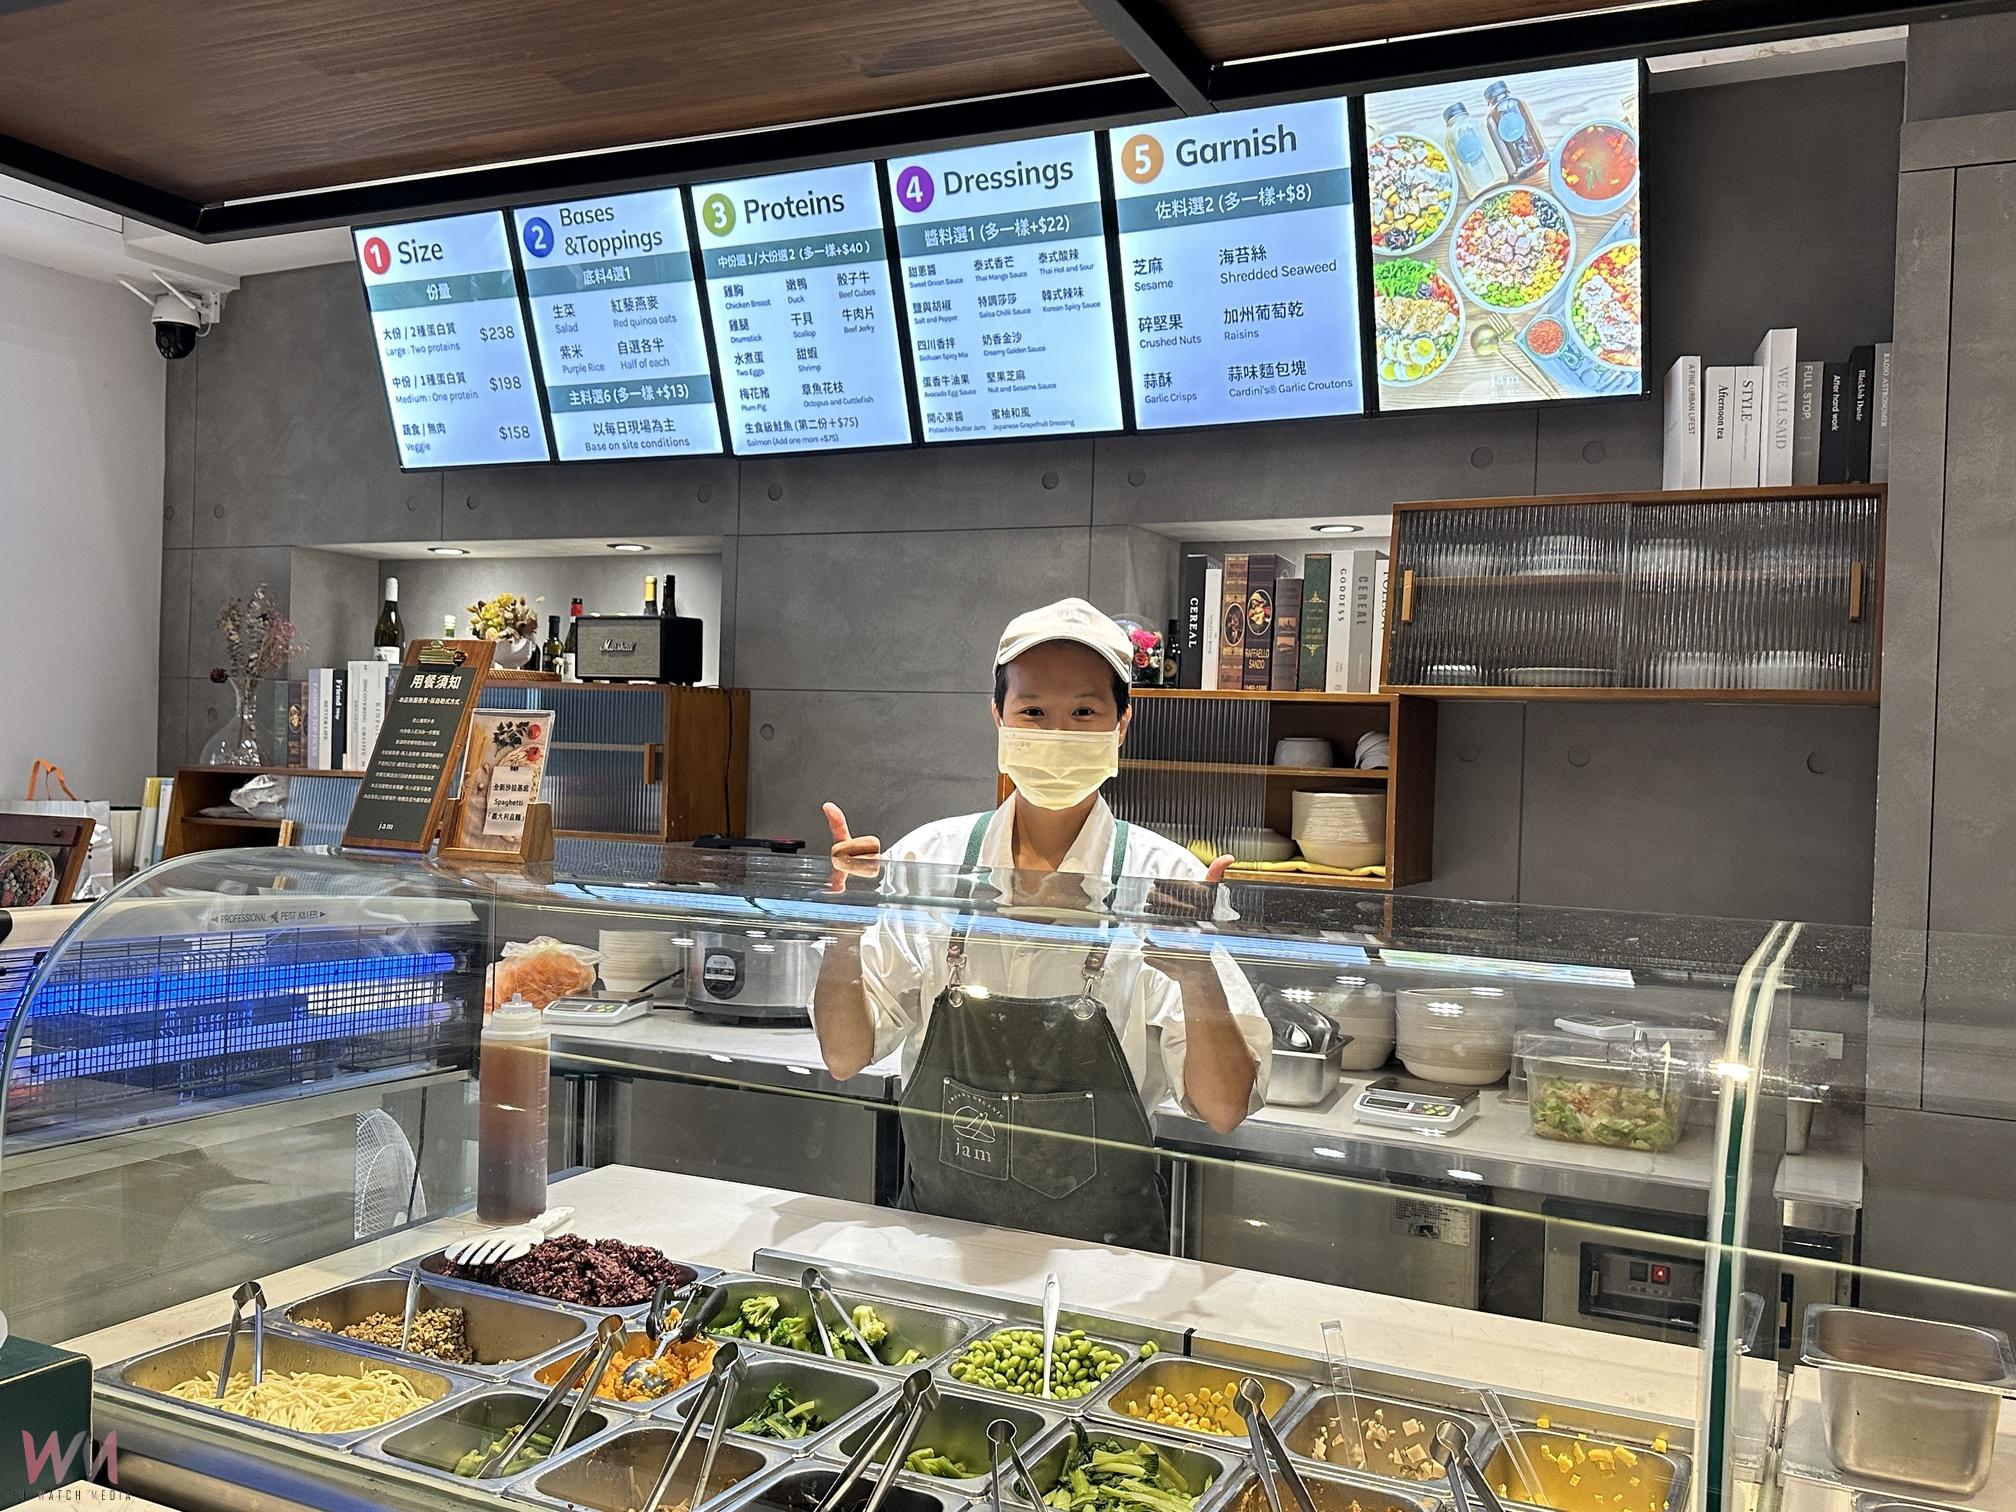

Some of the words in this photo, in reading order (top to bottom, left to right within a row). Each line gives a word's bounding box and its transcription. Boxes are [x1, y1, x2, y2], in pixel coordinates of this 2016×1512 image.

[1176, 124, 1296, 167] Garnish
[1135, 144, 1151, 175] 5
[944, 160, 1074, 196] Dressings
[906, 175, 923, 203] 4
[711, 201, 727, 229] 3
[744, 190, 844, 224] Proteins
[1155, 197, 1214, 220] 佐料選2
[560, 206, 614, 227] Bases
[531, 225, 546, 250] 2
[565, 230, 663, 258] &Toppings
[924, 226, 974, 247] 醬料選1
[370, 244, 382, 267] 1
[398, 239, 444, 264] Size
[1038, 249, 1079, 264] 泰式酸辣
[1219, 244, 1267, 266] 海苔絲
[974, 256, 1014, 271] 泰式香芒
[1133, 257, 1164, 276] 芝麻
[1220, 266, 1278, 284] Shredded
[1282, 259, 1337, 277] Seaweed
[582, 266, 630, 286] 底料4選1
[837, 270, 870, 286] 骰子牛
[426, 282, 452, 301] 份量
[1134, 279, 1174, 292] Sesame
[788, 296, 804, 304] Duck
[552, 304, 575, 319] 生菜
[791, 312, 814, 326] 干貝
[842, 306, 874, 322] 牛肉片
[1224, 300, 1304, 325] 加州葡萄乾
[556, 323, 578, 334] Salad
[614, 318, 628, 328] Red
[630, 317, 658, 327] quinoa
[660, 314, 677, 324] oats
[1138, 314, 1183, 332] 碎堅果
[480, 326, 514, 342] $238
[982, 332, 1022, 346] 奶香金沙
[1140, 336, 1178, 349] Crushed
[1180, 334, 1202, 346] Nuts
[1224, 328, 1260, 341] Raisins
[410, 345, 426, 354] Two
[428, 342, 460, 356] proteins
[560, 344, 584, 360] 紫米
[618, 338, 664, 356] 自選各半
[796, 346, 818, 360] 甜蝦
[562, 364, 587, 375] Purple
[588, 363, 604, 372] Rice
[620, 359, 638, 370] Half
[638, 358, 648, 368] of
[649, 357, 670, 368] each
[1228, 360, 1306, 382] 蒜味麵包塊
[1882, 353, 1890, 376] RADIO
[392, 376, 410, 388] 中份
[490, 376, 522, 392] $198
[1143, 372, 1173, 390] 蒜酥
[1278, 382, 1306, 394] Garlic
[1308, 378, 1353, 390] Croutons
[1778, 367, 1789, 388] WE
[1804, 366, 1813, 390] FULL
[1832, 375, 1840, 392] After
[432, 392, 448, 402] One
[450, 390, 478, 404] protein
[569, 388, 610, 406] 主料選6
[740, 386, 770, 400] 梅花豬
[802, 380, 844, 396] 章魚花枝
[1145, 393, 1169, 404] Garlic
[1170, 392, 1198, 404] Crisps
[1688, 388, 1696, 412] URBAN
[1718, 385, 1728, 426] Afternoon
[1741, 380, 1753, 422] STYLE
[1777, 390, 1788, 416] ALL
[1832, 395, 1840, 412] hard
[499, 425, 530, 441] $158
[593, 418, 676, 437] 以每日現場為主
[1776, 419, 1787, 449] SAID
[586, 442, 606, 452] Base
[608, 442, 620, 450] on
[622, 440, 638, 449] site
[640, 436, 690, 448] conditions
[1339, 568, 1347, 622] GODDESS
[1357, 576, 1368, 625] CEREAL
[1188, 597, 1198, 648] CEREAL
[410, 674, 462, 690] 用餐須知
[494, 798, 524, 807] Spaghetti
[378, 821, 394, 831] jam
[221, 913, 266, 924] PROFESSIONAL
[281, 912, 295, 920] PEST
[298, 910, 318, 920] KILLER
[956, 1138, 990, 1162] jam
